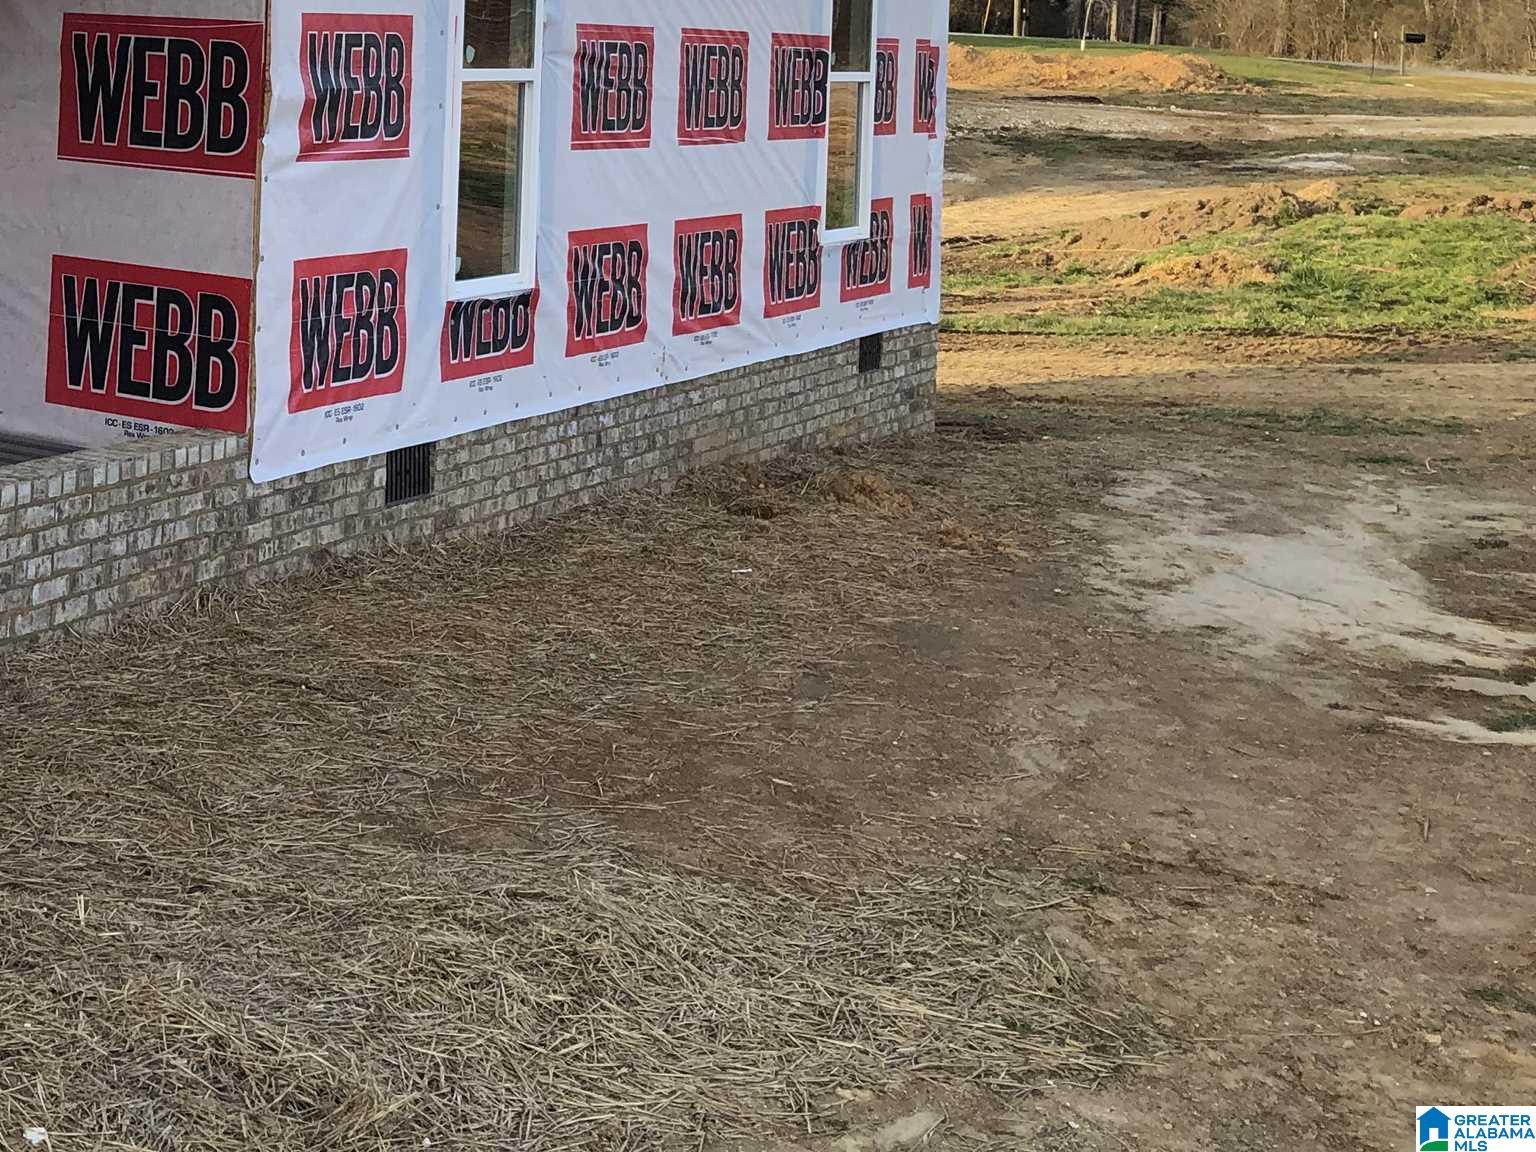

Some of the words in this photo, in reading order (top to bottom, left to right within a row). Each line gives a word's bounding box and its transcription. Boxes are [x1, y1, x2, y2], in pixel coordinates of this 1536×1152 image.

[72, 30, 249, 156] WEBB
[307, 31, 405, 143] WEBB
[579, 42, 647, 134] WEBB
[682, 44, 745, 130] WEBB
[774, 46, 830, 128] WEBB
[573, 239, 642, 341] WEBB
[677, 229, 739, 321] WEBB
[767, 218, 821, 305] WEBB
[61, 274, 238, 414] WEBB
[298, 268, 399, 393] WEBB
